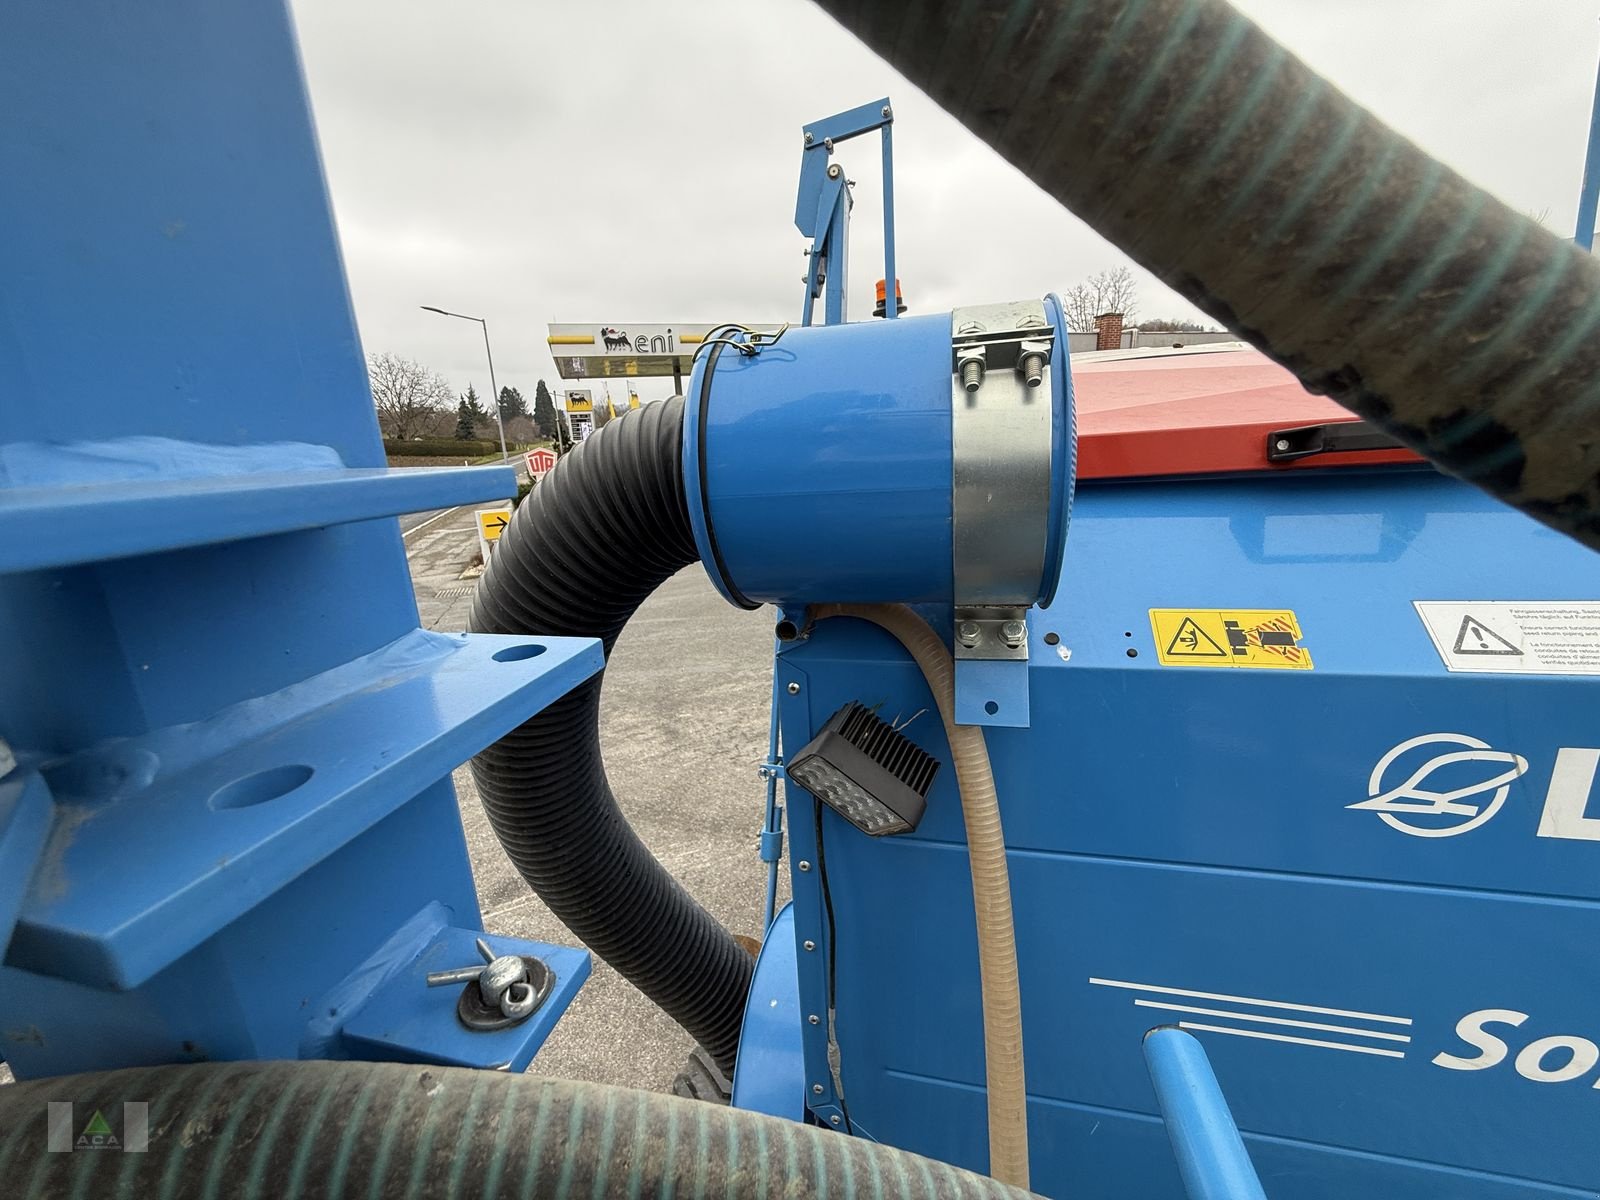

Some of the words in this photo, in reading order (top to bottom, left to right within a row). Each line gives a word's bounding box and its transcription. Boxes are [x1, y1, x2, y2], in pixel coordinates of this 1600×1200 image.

[634, 328, 674, 353] eni
[527, 450, 555, 473] UTA
[1536, 747, 1600, 841] L
[1431, 1008, 1600, 1090] So
